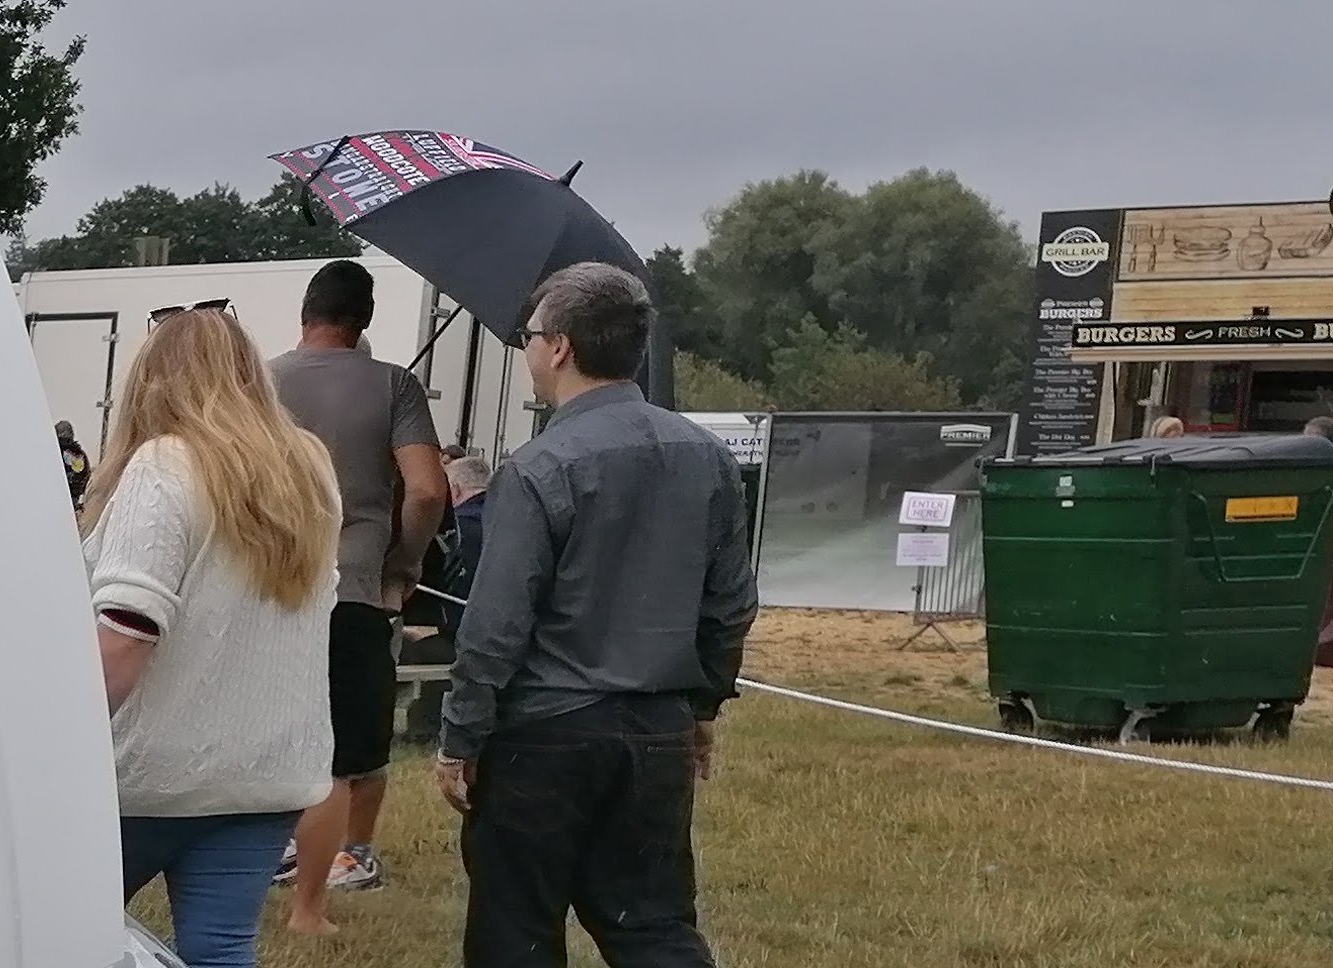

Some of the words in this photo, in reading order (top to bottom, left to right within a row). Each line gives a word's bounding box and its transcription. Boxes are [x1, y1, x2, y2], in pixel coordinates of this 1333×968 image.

[361, 135, 431, 186] WOODCOTE
[302, 143, 390, 211] STOWE
[1046, 248, 1079, 257] GRILL
[1081, 247, 1105, 256] BAR
[1039, 308, 1103, 319] BURGERS
[1076, 326, 1176, 343] BURGERS
[1218, 326, 1271, 338] FRESH
[940, 431, 991, 440] PREMIER
[912, 500, 944, 509] ENTER
[913, 508, 939, 519] HERE
